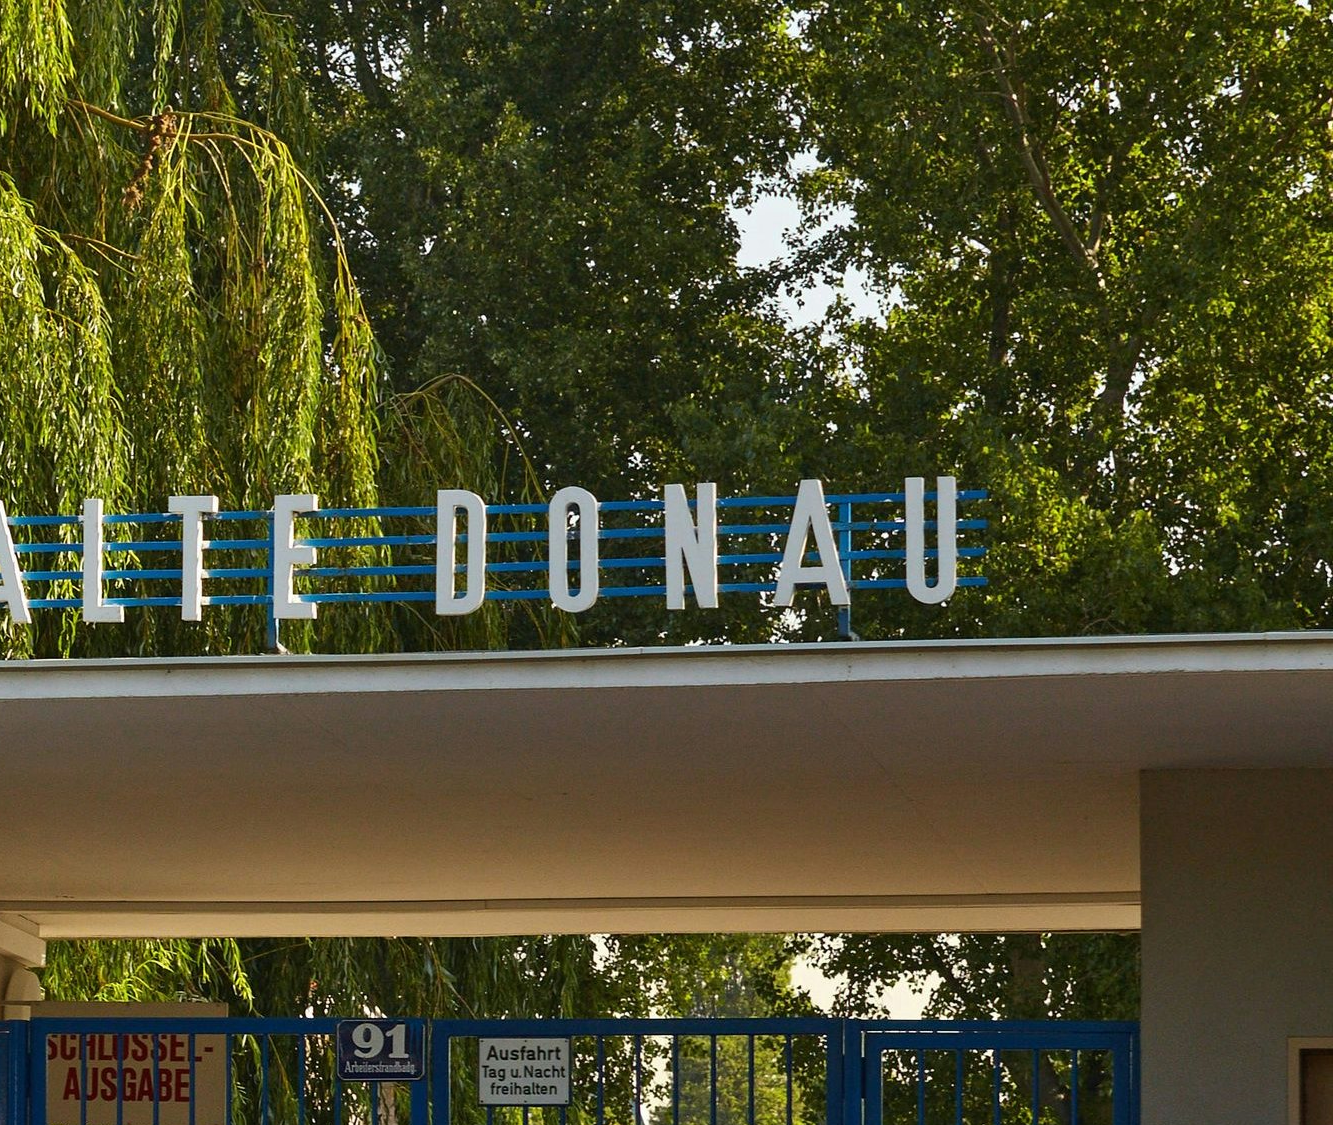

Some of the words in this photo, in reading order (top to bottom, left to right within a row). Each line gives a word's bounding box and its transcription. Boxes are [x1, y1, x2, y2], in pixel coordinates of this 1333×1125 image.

[435, 475, 959, 616] DONAU
[352, 1023, 410, 1059] 91
[486, 1045, 562, 1061] Ausfahrt
[62, 1067, 191, 1103] AUSGABE
[481, 1065, 506, 1082] Tag
[490, 1082, 558, 1096] freihalten
